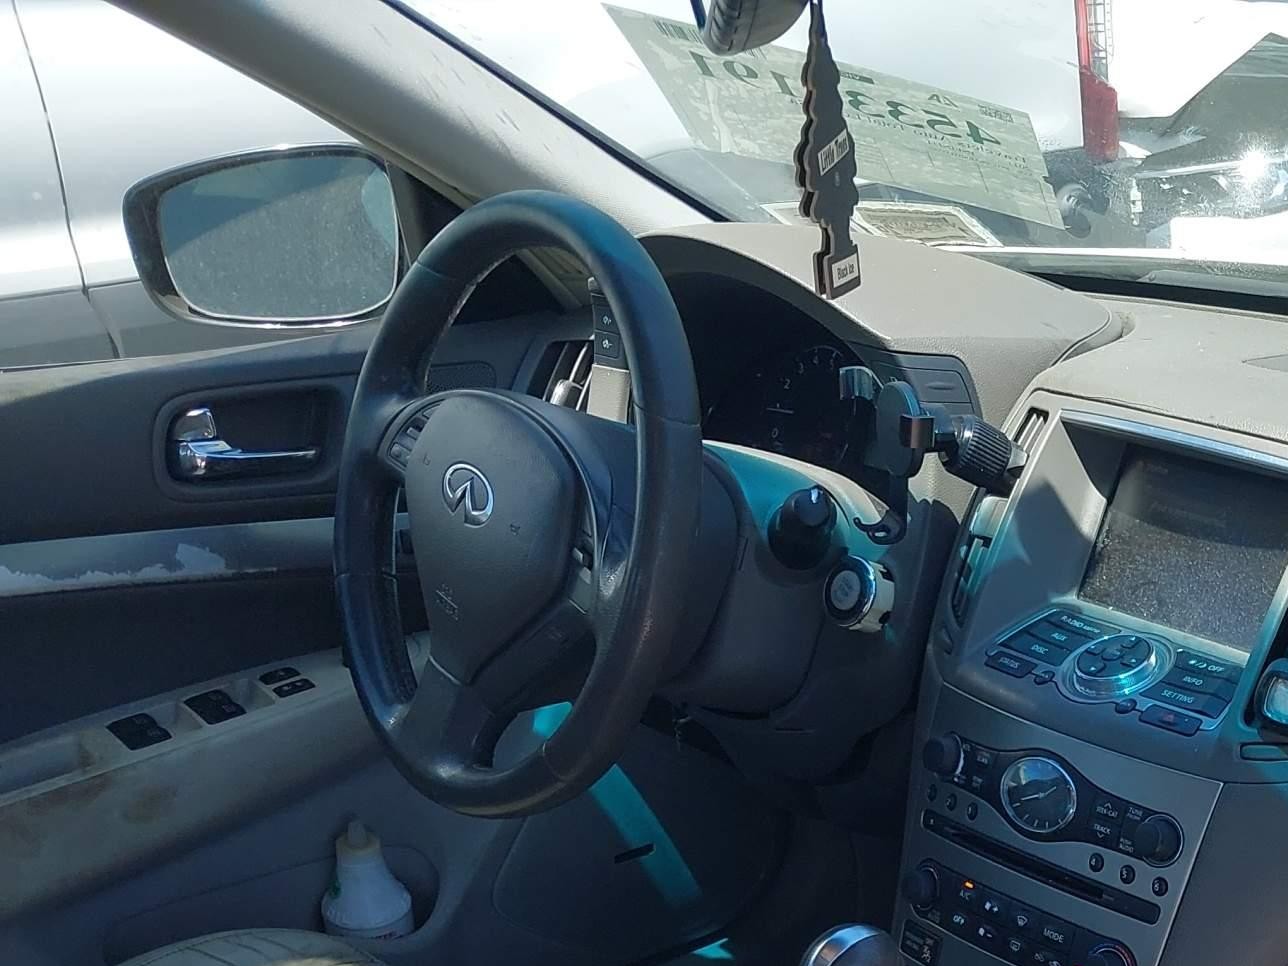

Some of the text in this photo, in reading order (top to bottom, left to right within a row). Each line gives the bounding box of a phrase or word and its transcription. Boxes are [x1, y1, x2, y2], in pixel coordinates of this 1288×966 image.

[836, 262, 855, 281] Black Ice
[784, 379, 790, 389] 2
[772, 428, 779, 438] 0
[1207, 664, 1225, 673] OFF
[1182, 675, 1203, 686] INFO
[1160, 689, 1196, 704] SETTING
[1042, 927, 1065, 944] MODE
